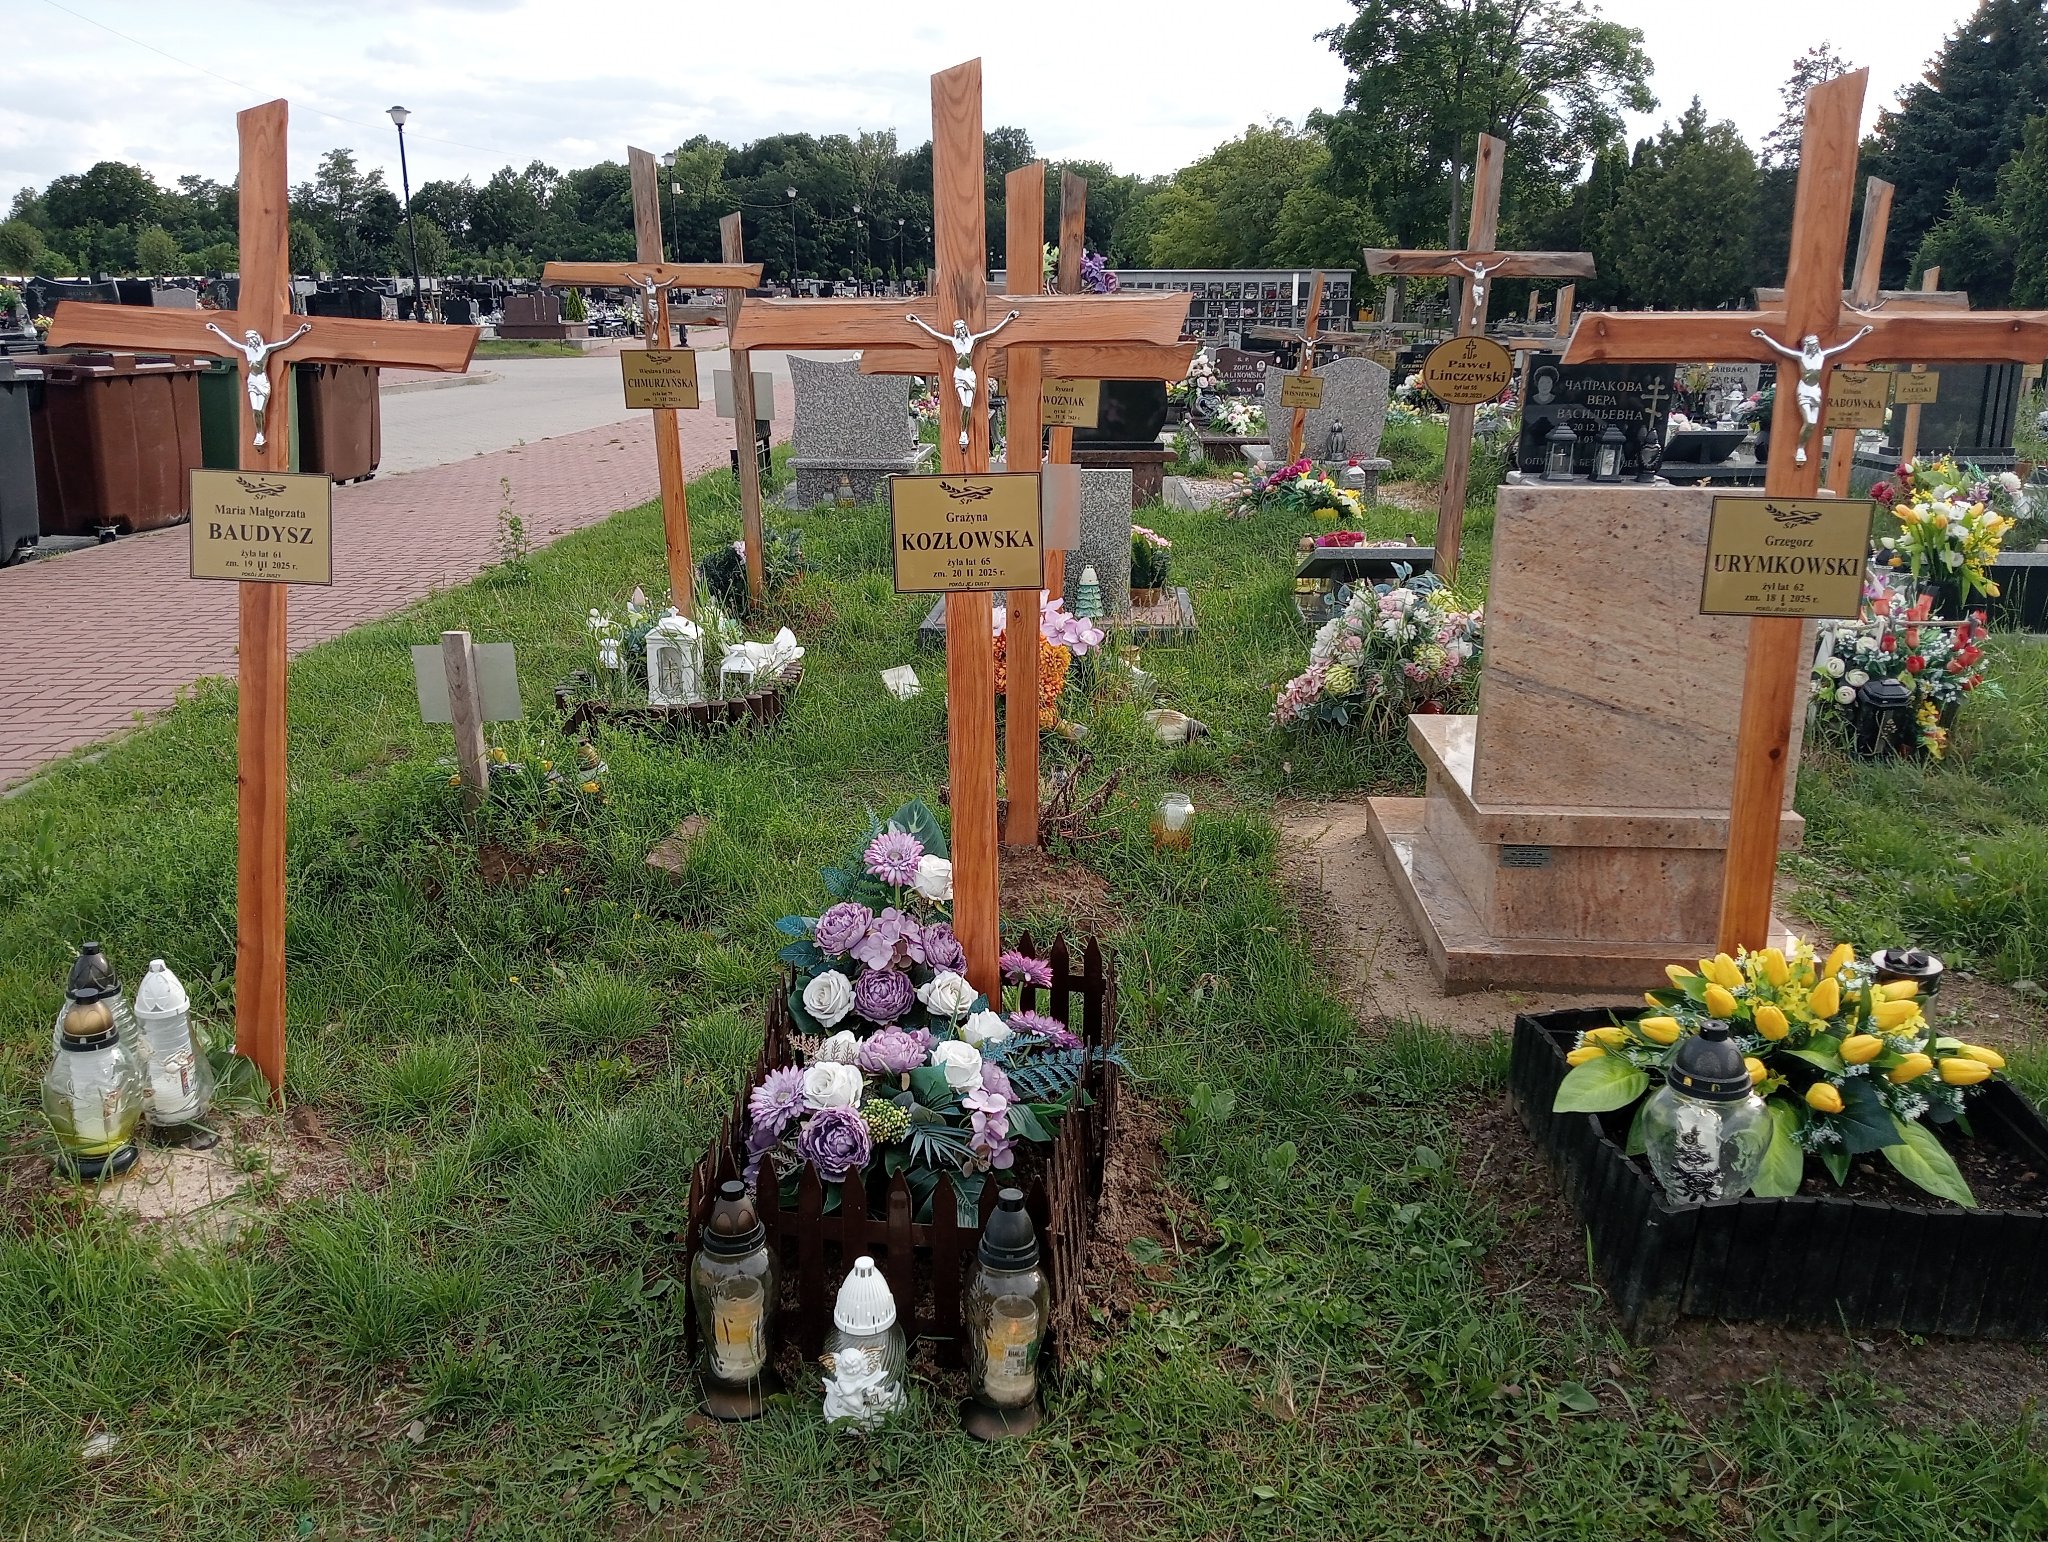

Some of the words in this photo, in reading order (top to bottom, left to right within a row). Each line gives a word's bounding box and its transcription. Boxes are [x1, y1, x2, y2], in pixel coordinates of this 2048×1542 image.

[628, 376, 694, 388] CHMURZYŃSKA
[1430, 369, 1506, 383] Linczewski
[1565, 380, 1644, 393] ЧАПРАКОВА
[1043, 394, 1086, 407] WOŹNIAK
[1587, 395, 1617, 406] ВЕРА
[1827, 398, 1882, 409] RABOWSKA
[1557, 409, 1644, 421] ВАСИЛЬЕВНА
[215, 505, 246, 516] Maria
[946, 512, 989, 525] Grażyna
[208, 523, 314, 545] BAUDYSZ
[901, 530, 1034, 551] KOZŁOWSKA
[1765, 535, 1815, 549] Grzegorz
[259, 550, 269, 558] lat
[244, 560, 253, 568] 19
[257, 561, 268, 569] III
[272, 562, 291, 570] 2025
[965, 558, 977, 566] lat
[981, 557, 991, 566] 65
[1714, 554, 1860, 577] URYMKOWSKI
[952, 569, 962, 578] 20
[966, 569, 974, 577] II
[978, 568, 998, 577] 2025
[1777, 583, 1789, 591] lat
[1793, 584, 1805, 592] 62
[1766, 594, 1777, 602] 18
[1790, 594, 1811, 603] 2025
